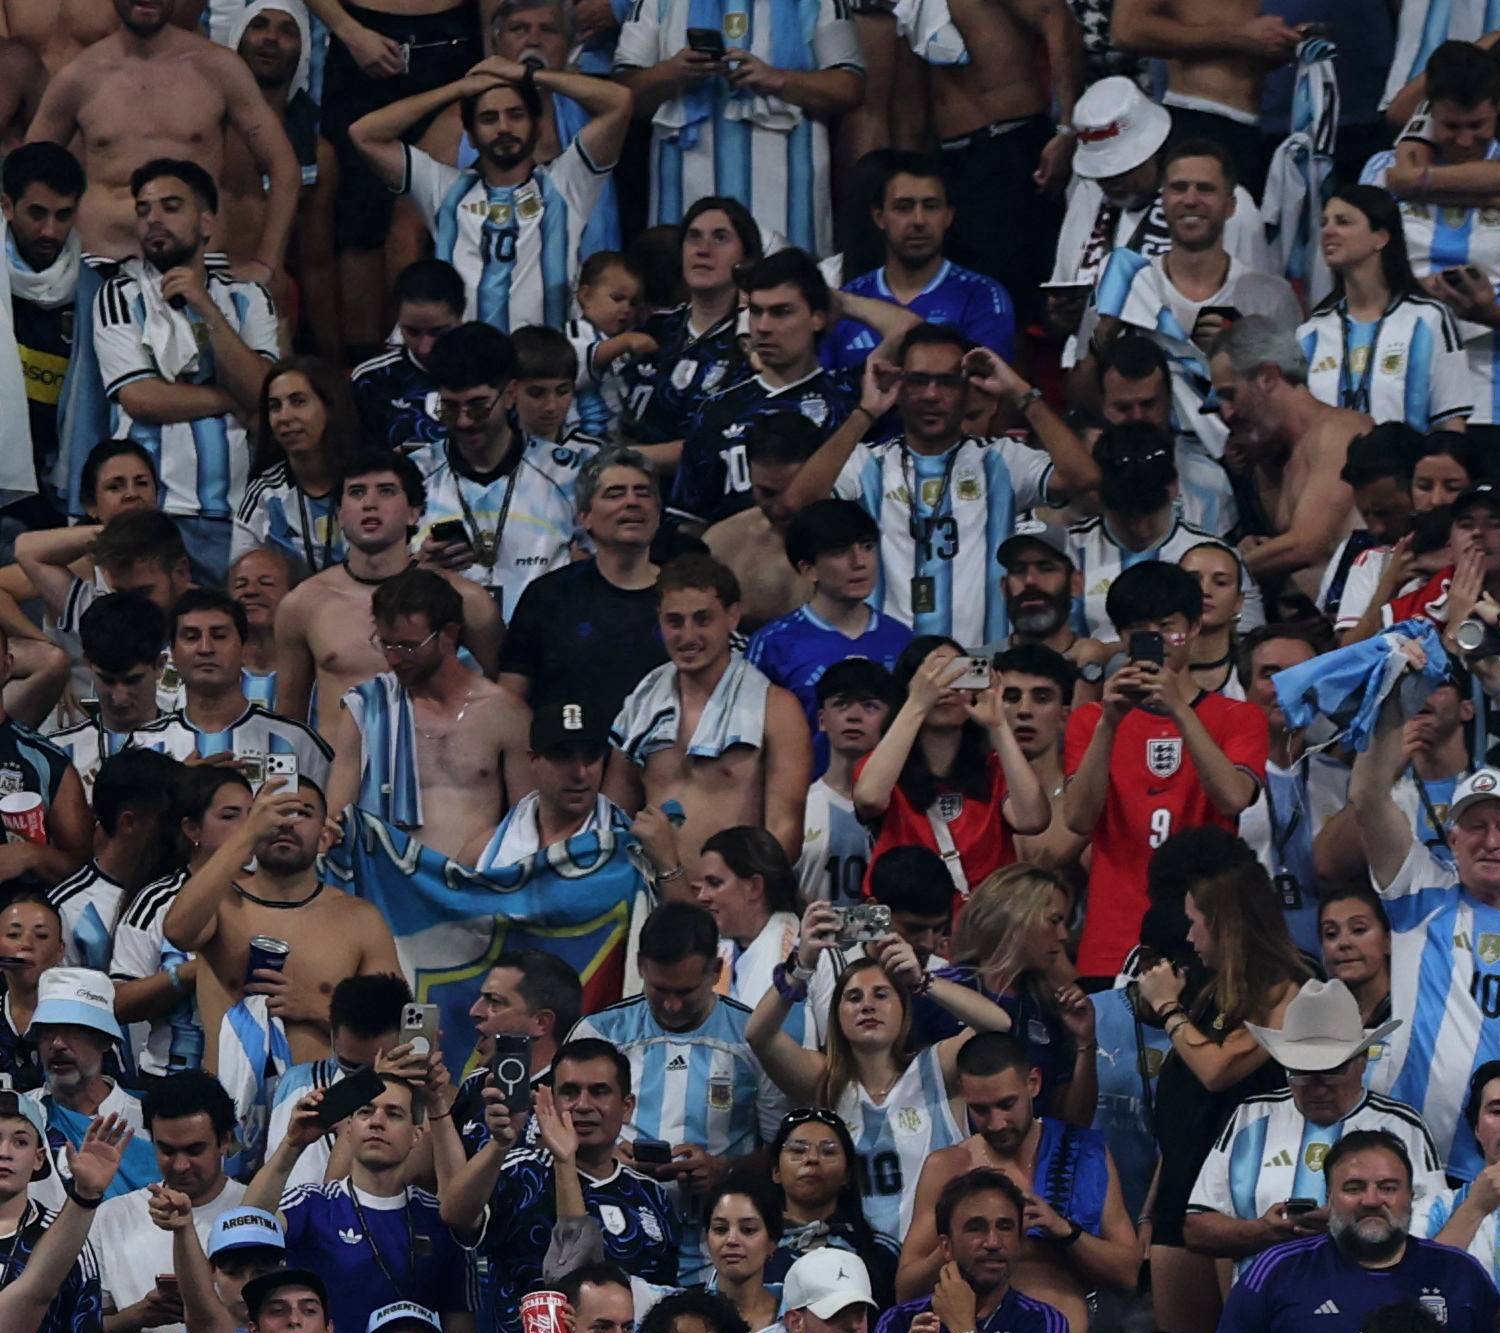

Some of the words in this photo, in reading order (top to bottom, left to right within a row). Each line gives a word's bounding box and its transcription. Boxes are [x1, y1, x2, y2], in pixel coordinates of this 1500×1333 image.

[1150, 808, 1171, 849] 9
[222, 1213, 279, 1232] ARGENTINA
[375, 1301, 435, 1322] ARGENTINA
